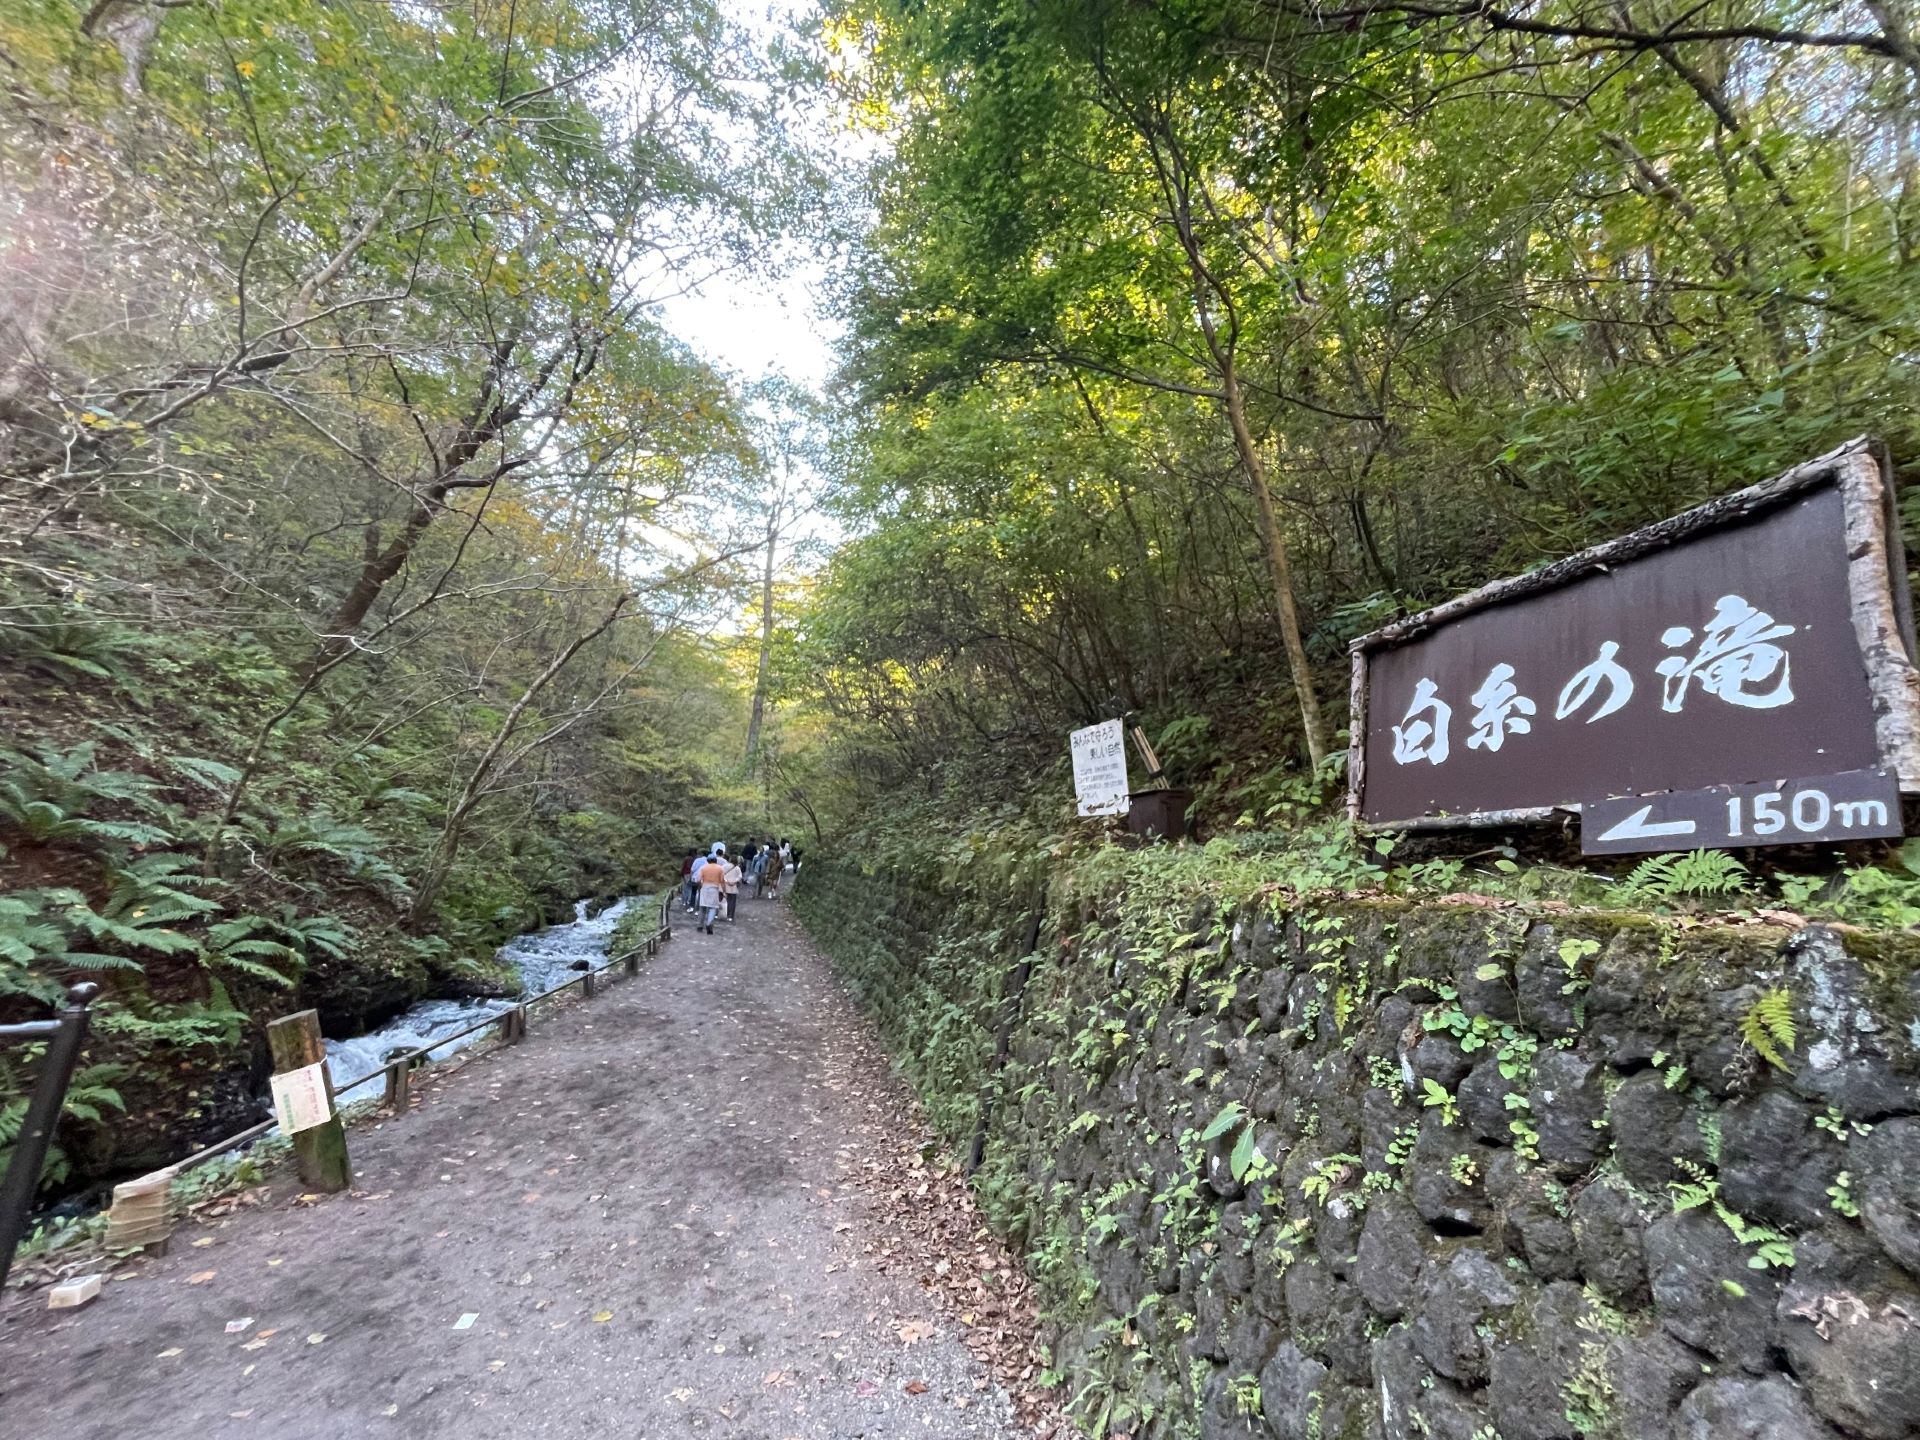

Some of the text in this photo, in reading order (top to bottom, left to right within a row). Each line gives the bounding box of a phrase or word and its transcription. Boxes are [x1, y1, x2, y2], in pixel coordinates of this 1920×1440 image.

[1392, 594, 1796, 766] 白糸の滝
[1725, 788, 1889, 837] 150m
